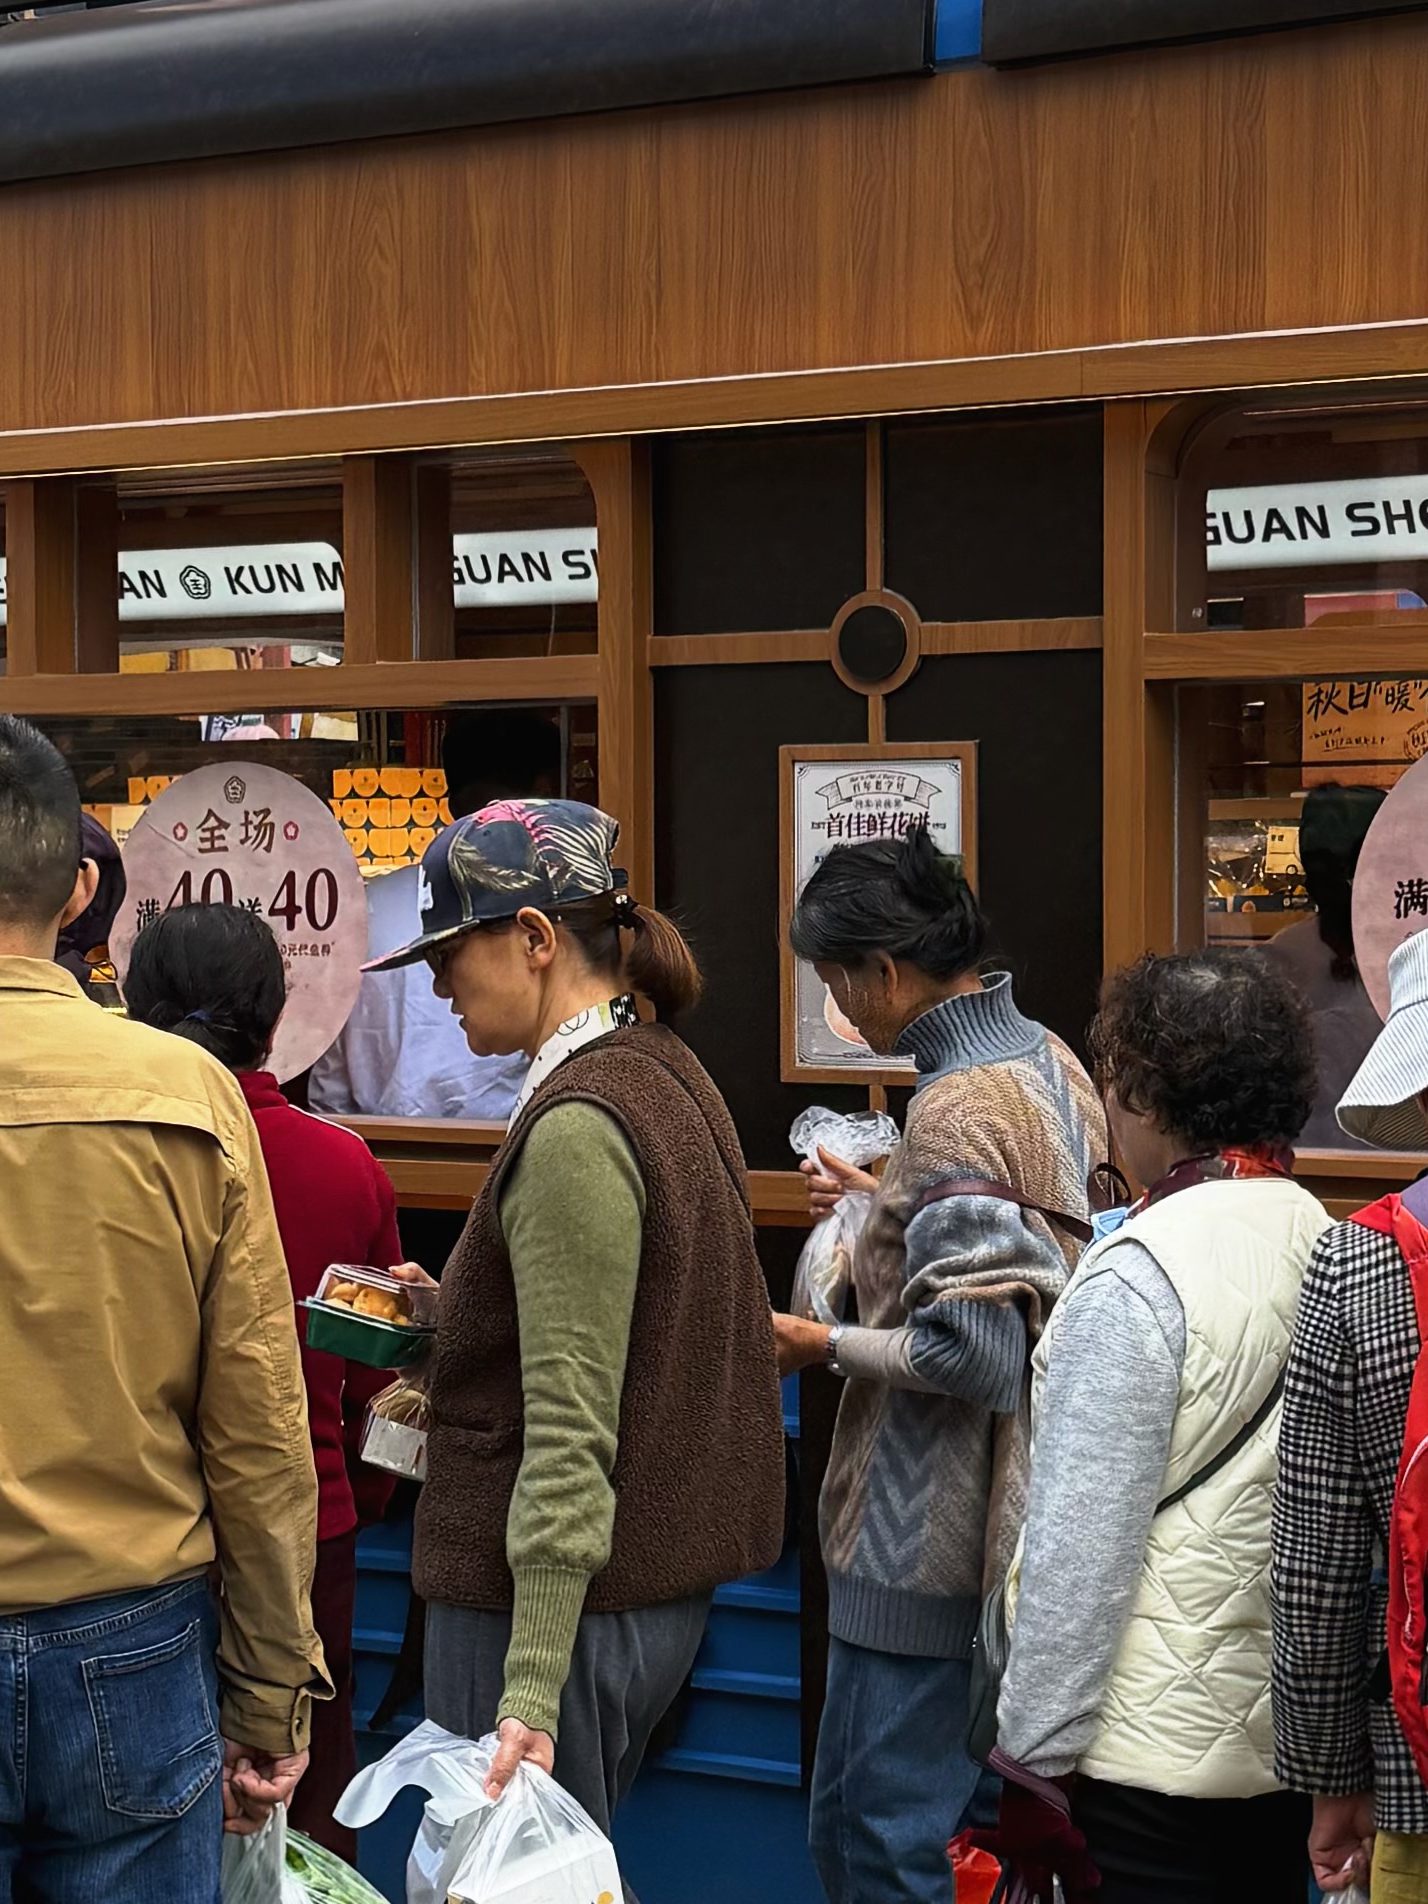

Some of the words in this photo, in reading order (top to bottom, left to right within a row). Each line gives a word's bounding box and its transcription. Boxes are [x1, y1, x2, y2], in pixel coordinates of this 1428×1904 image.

[223, 562, 305, 595] KUN
[561, 548, 598, 581] S
[196, 807, 276, 854] 全场
